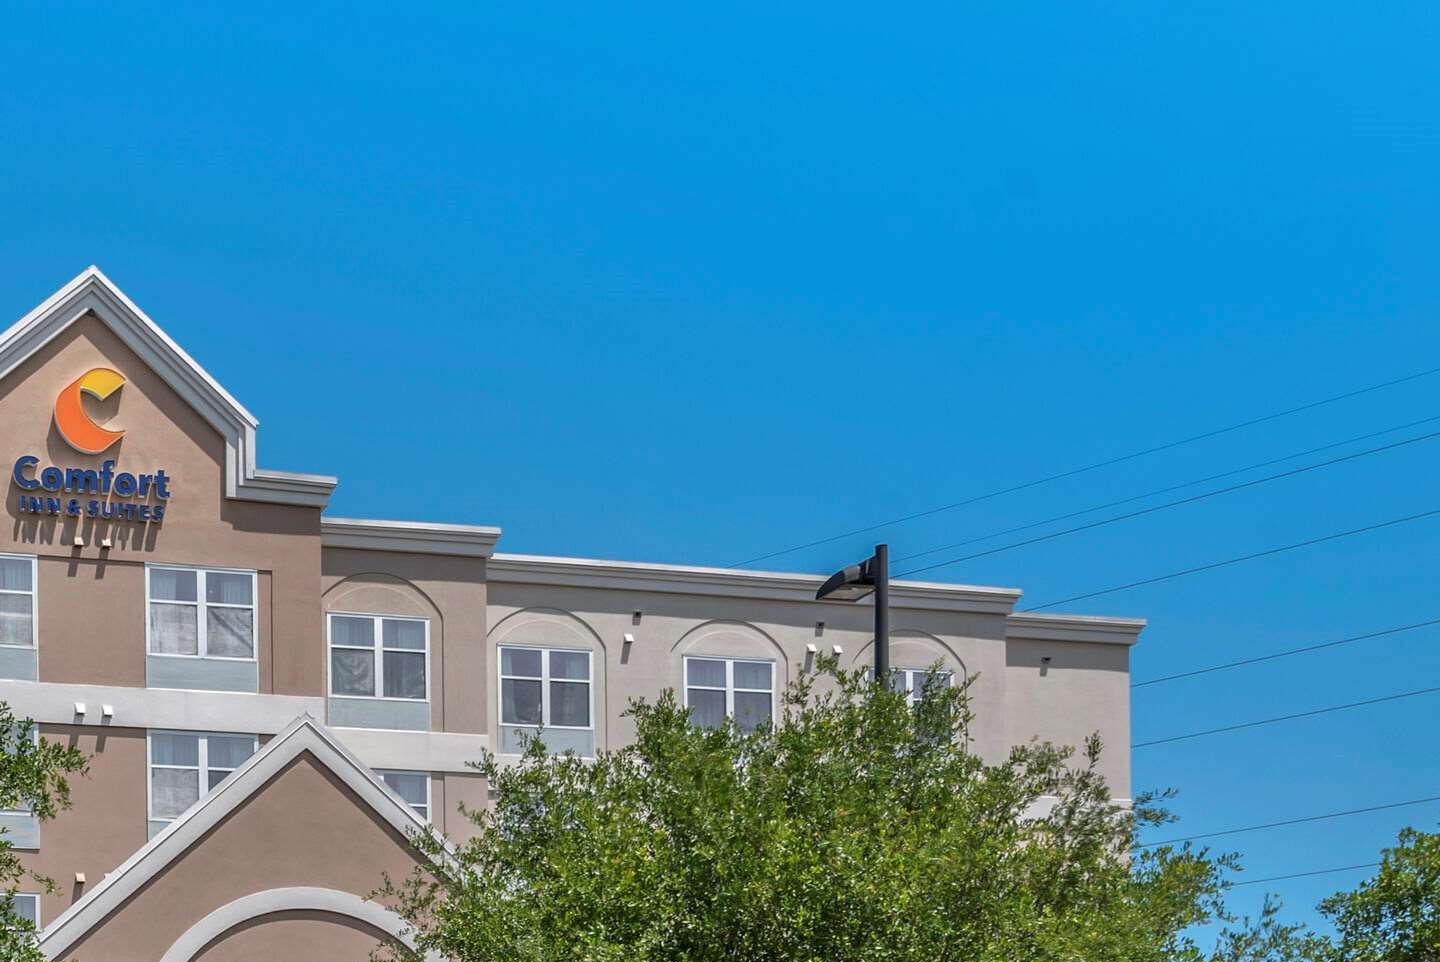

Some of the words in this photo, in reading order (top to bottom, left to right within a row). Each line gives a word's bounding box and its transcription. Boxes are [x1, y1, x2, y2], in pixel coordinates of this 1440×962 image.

[13, 455, 170, 499] Comfort
[20, 495, 60, 514] INN
[67, 499, 81, 516] &
[86, 500, 165, 522] SUITES
